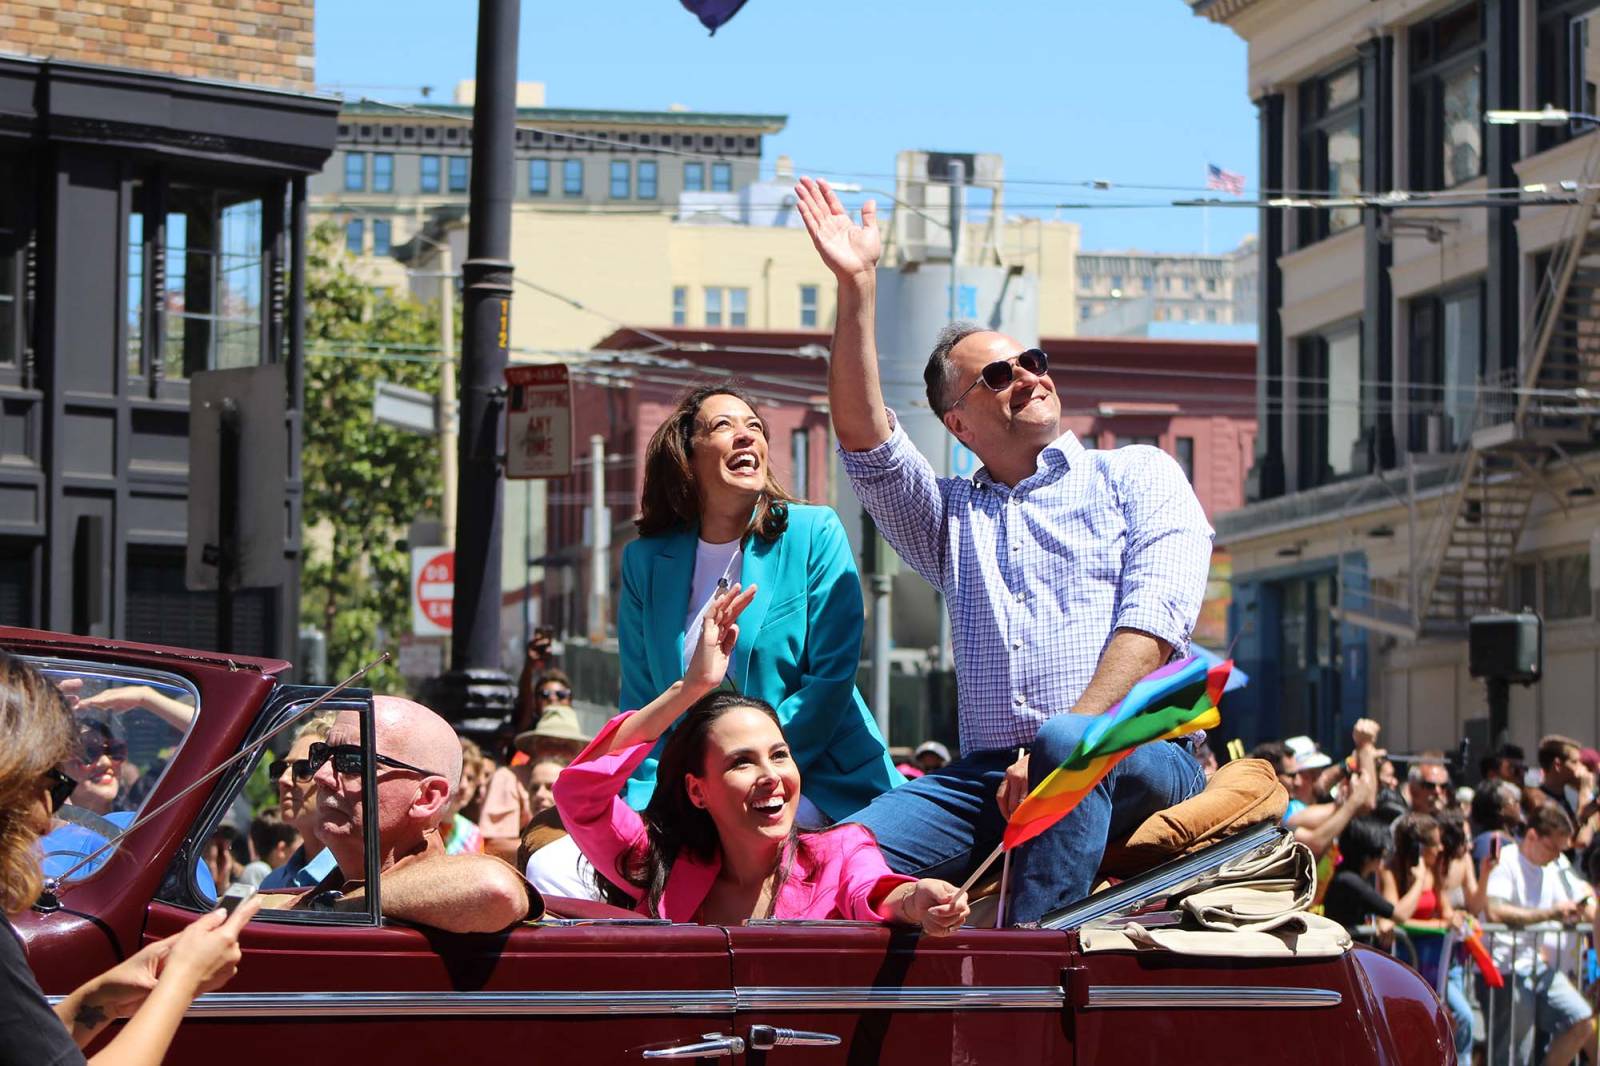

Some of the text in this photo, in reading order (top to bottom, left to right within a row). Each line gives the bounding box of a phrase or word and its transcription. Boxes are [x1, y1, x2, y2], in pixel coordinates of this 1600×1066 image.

[498, 299, 509, 349] 112
[528, 415, 552, 432] ANY
[428, 601, 453, 618] EN
